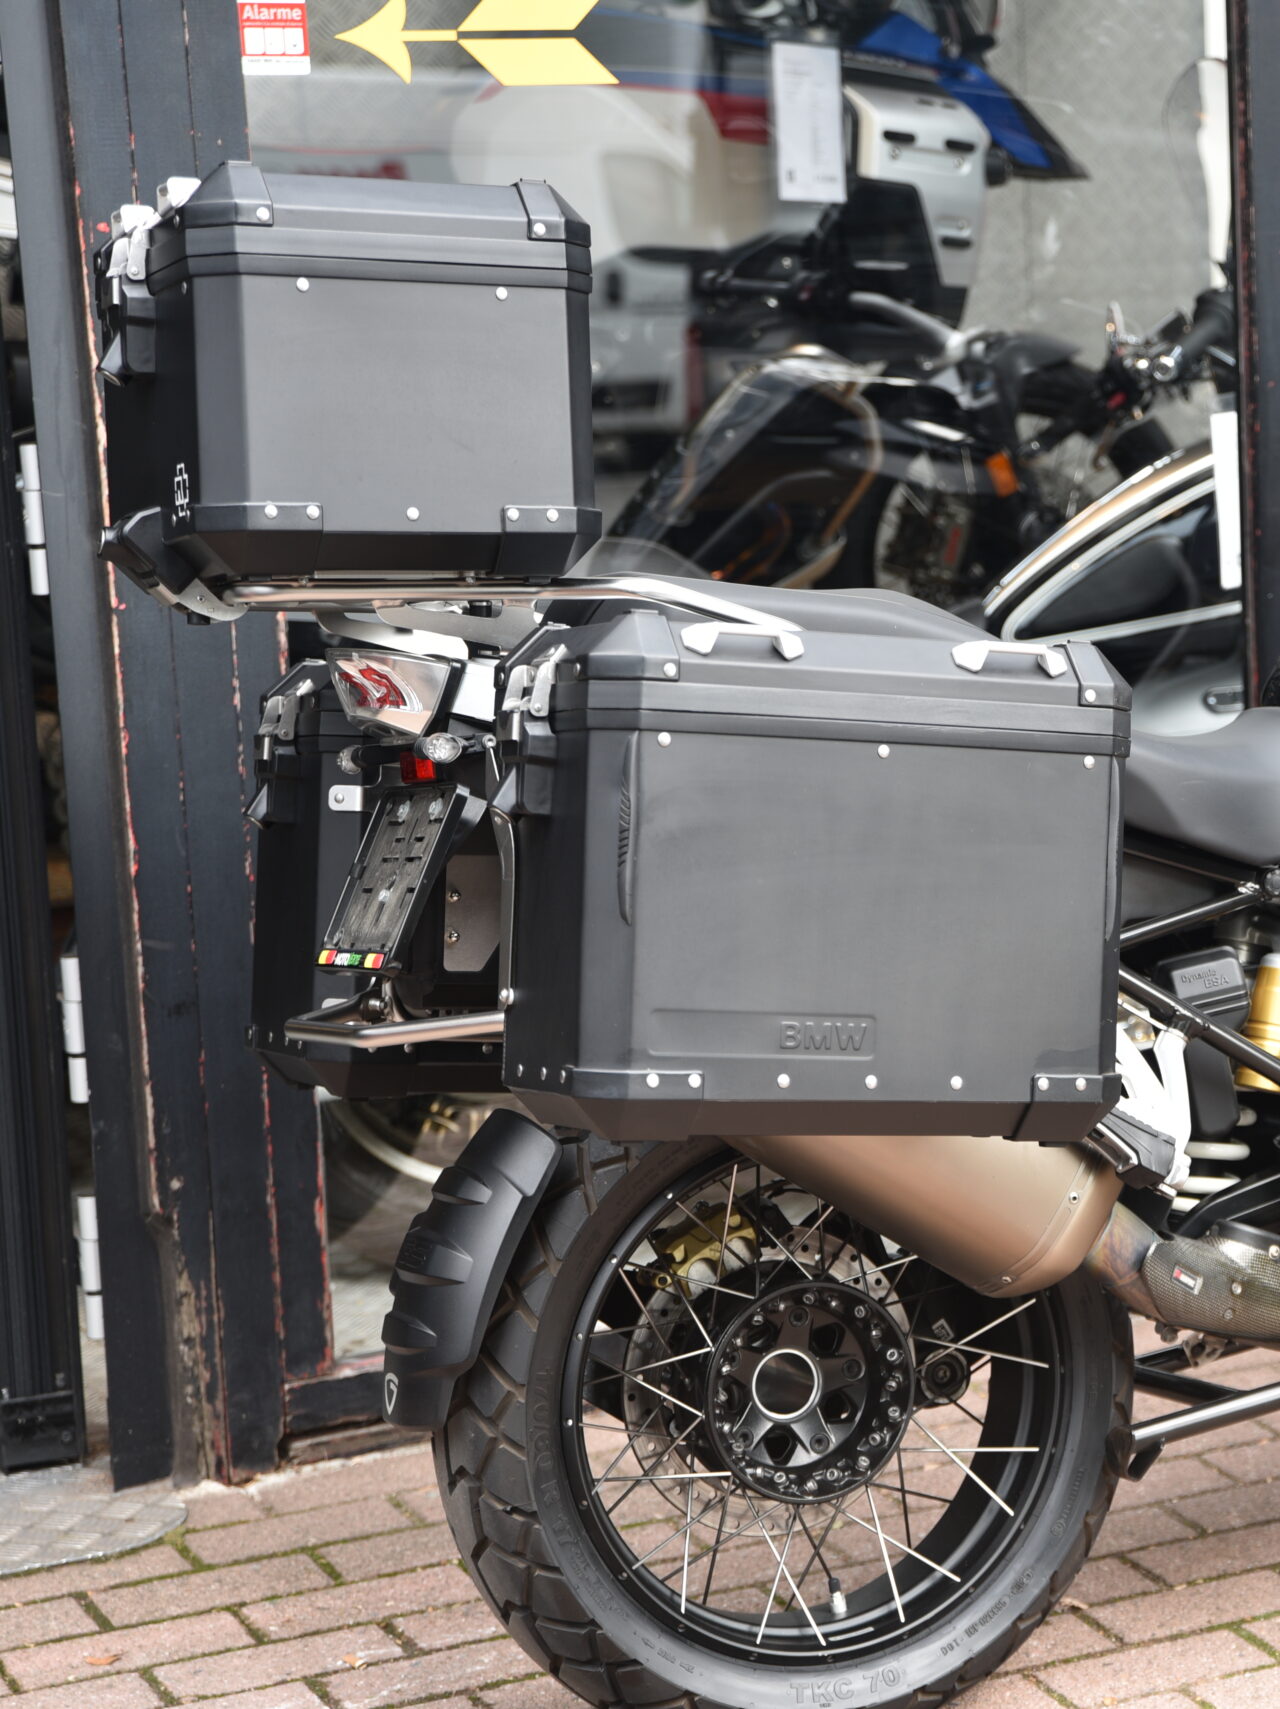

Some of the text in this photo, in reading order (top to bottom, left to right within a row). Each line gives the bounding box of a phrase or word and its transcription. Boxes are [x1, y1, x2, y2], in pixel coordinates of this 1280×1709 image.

[242, 4, 303, 20] Alarme
[1180, 968, 1217, 983] Dynamic
[1203, 975, 1230, 989] ESA
[779, 1020, 868, 1052] BMW
[789, 1665, 902, 1704] TKC 70
